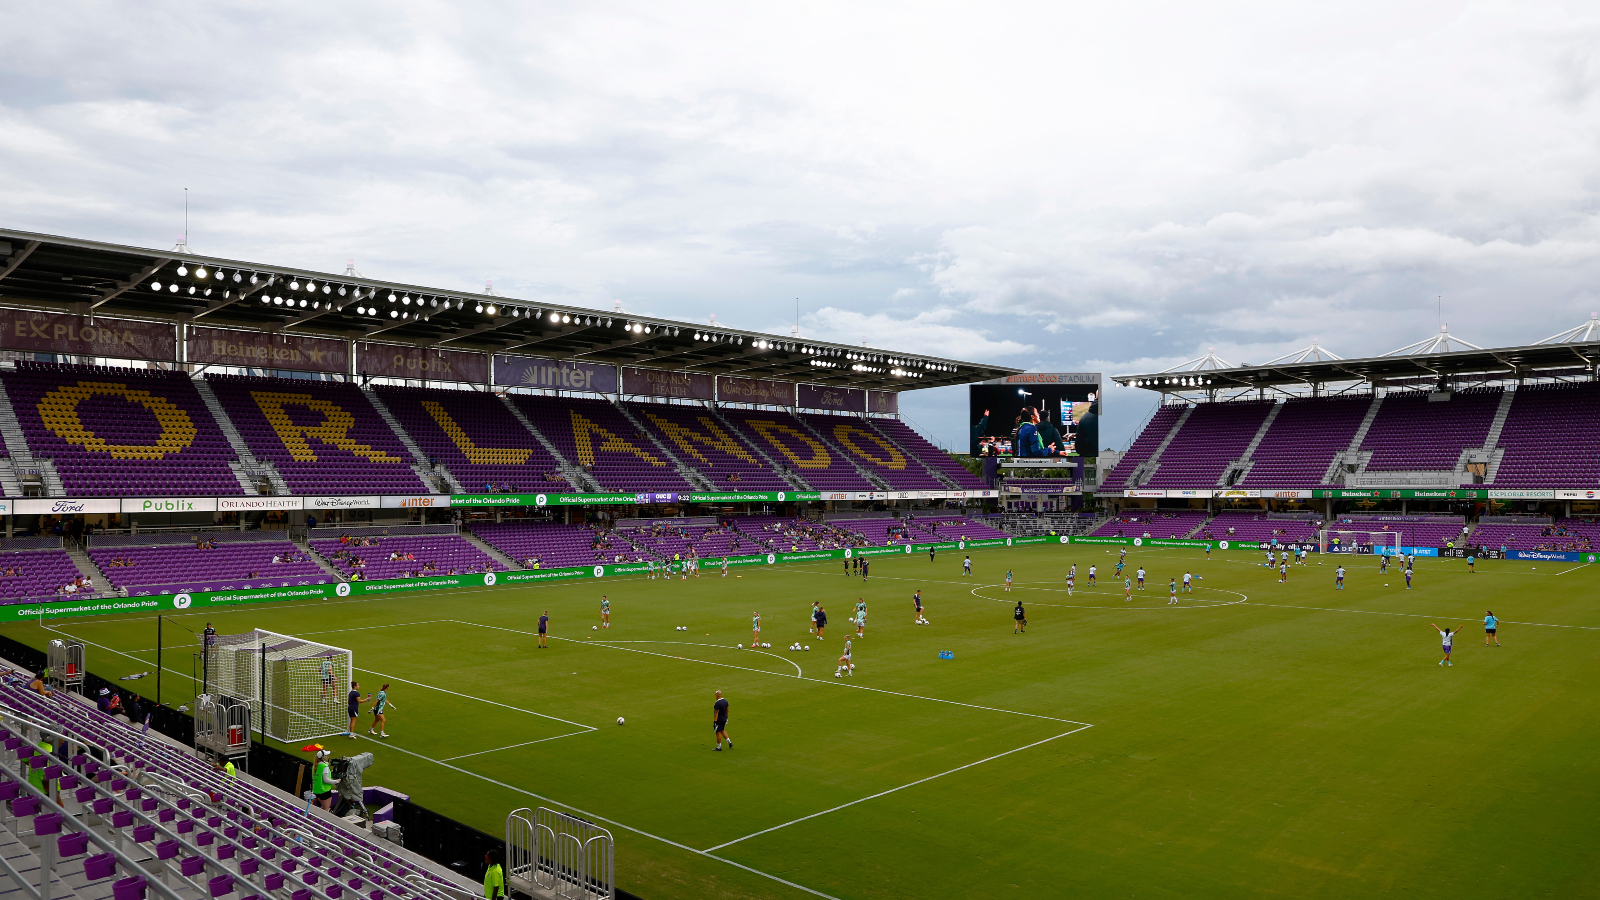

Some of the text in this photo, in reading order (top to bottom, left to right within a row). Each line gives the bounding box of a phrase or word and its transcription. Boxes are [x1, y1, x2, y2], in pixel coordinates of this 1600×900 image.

[15, 317, 136, 344] EXPLORIA
[212, 340, 301, 362] Heineken
[393, 355, 452, 372] Publix
[541, 365, 594, 388] inter
[646, 372, 692, 386] ORLANDO
[652, 385, 687, 396] HEALTH
[722, 381, 788, 400] Walt Disney World
[820, 391, 844, 406] Ford
[52, 501, 84, 512] Ford
[143, 500, 194, 510] Publix
[314, 498, 330, 506] Walt
[408, 497, 434, 507] inter
[233, 593, 269, 601] Supermarket
[45, 605, 91, 615] Supermarket
